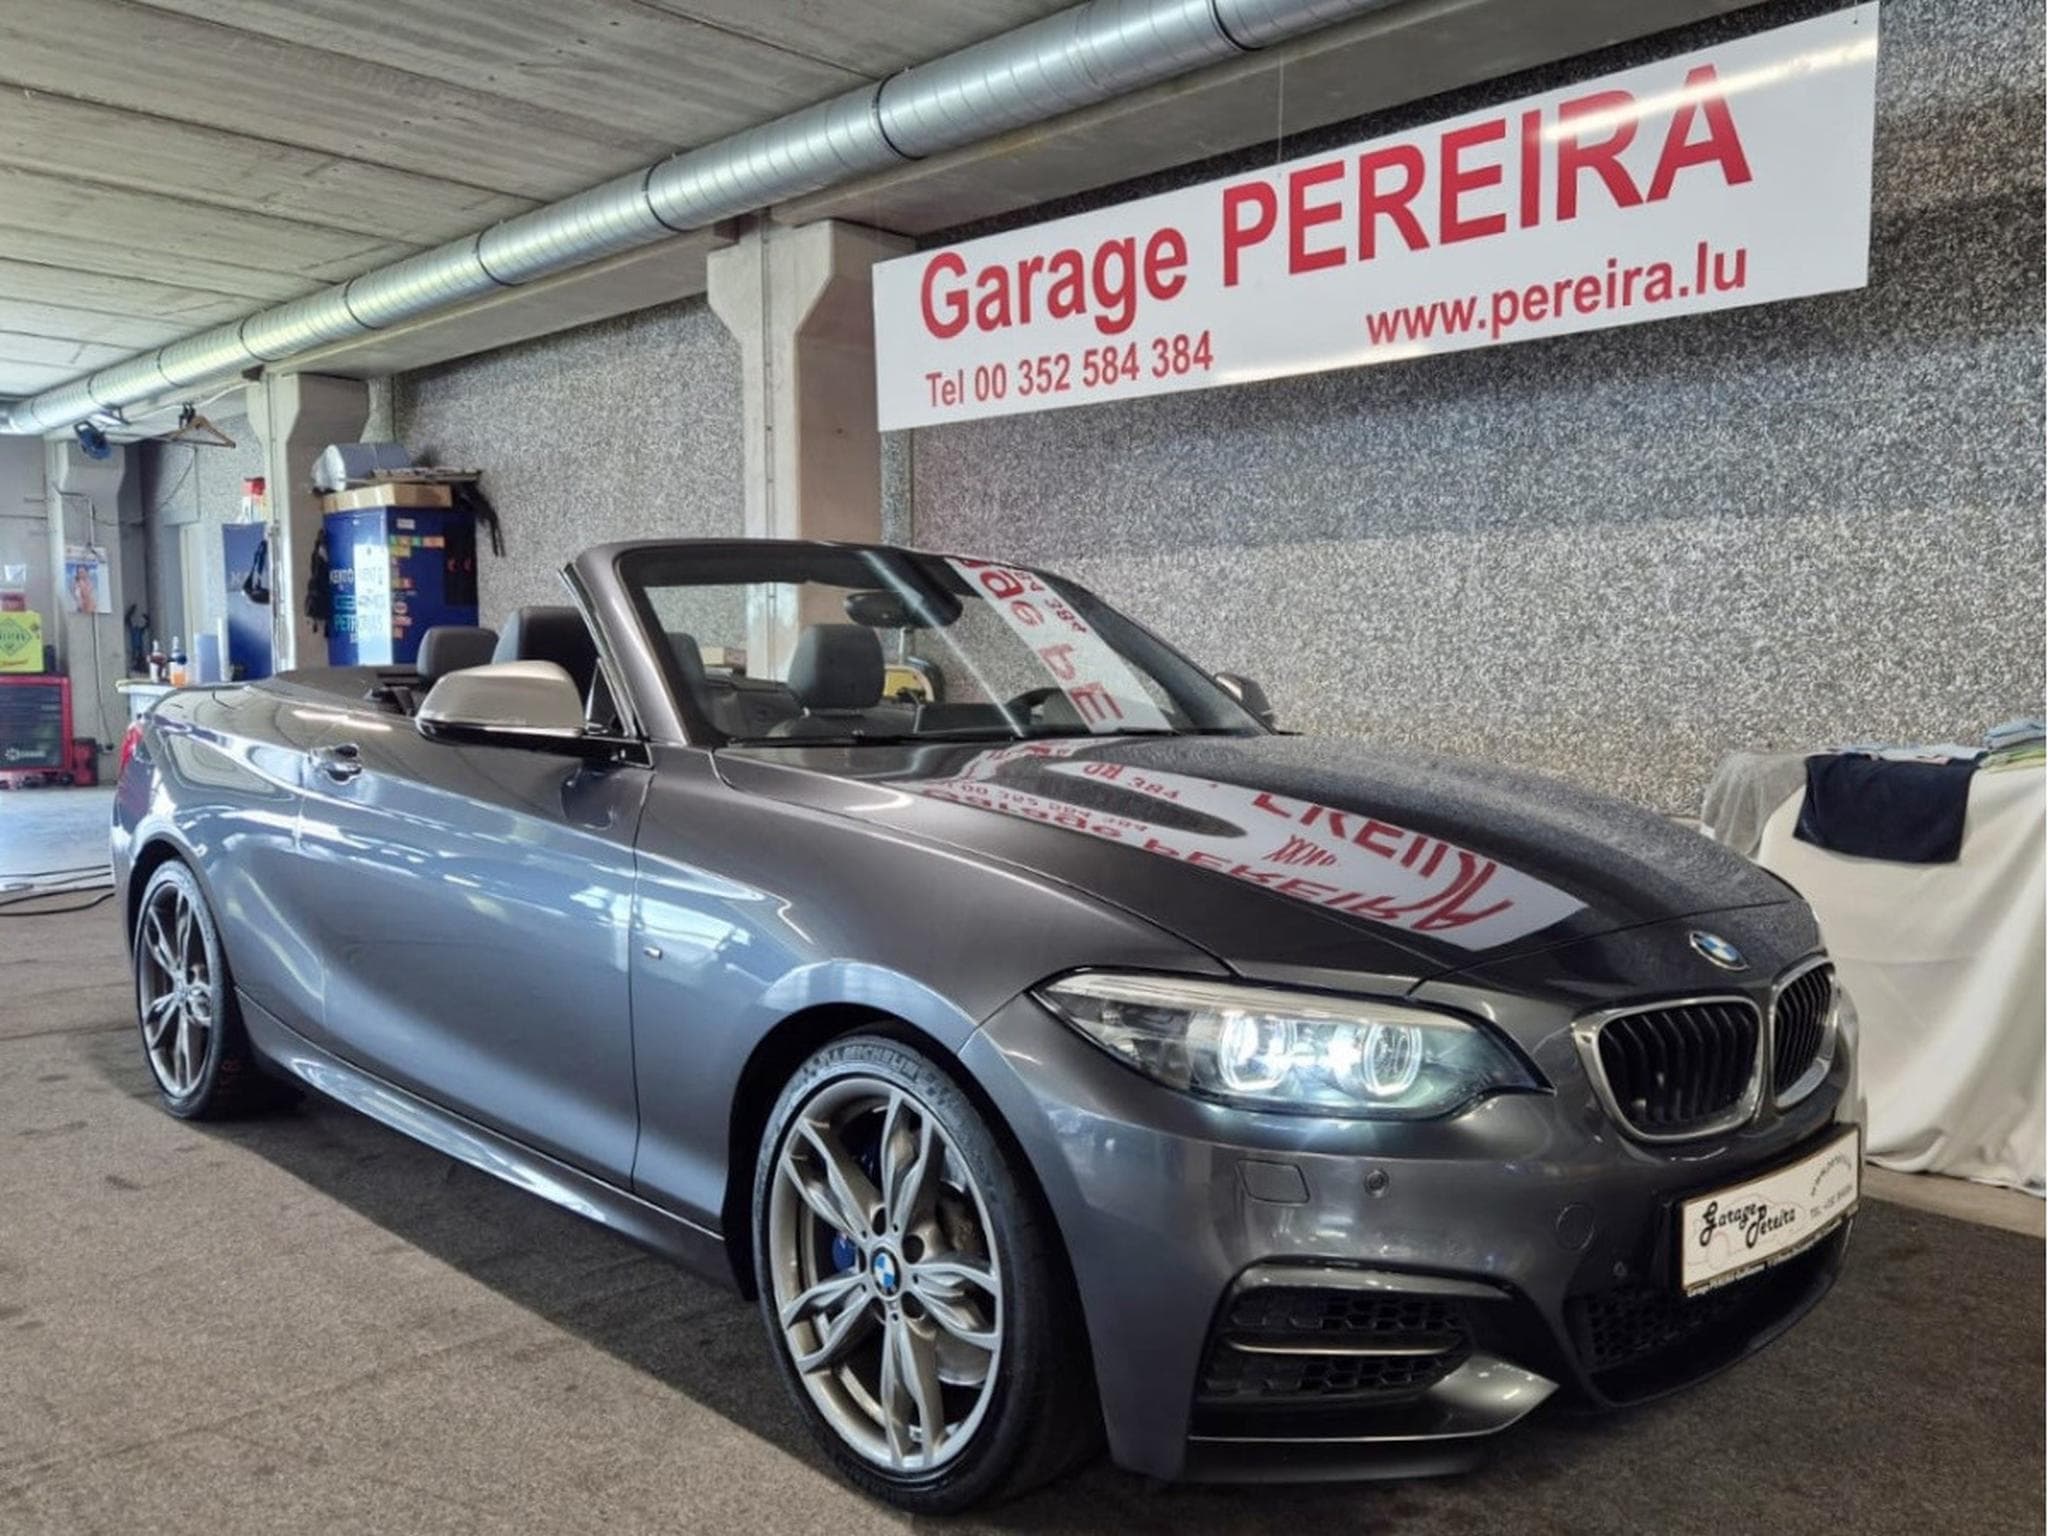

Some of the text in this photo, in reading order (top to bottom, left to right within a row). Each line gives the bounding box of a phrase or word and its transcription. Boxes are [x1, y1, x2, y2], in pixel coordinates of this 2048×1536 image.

[921, 63, 1752, 339] Garage PEREIRA
[1366, 242, 1748, 345] www.pereira.lu
[925, 330, 1214, 407] Tel 00 352 584 384
[1699, 1201, 1757, 1247] Garage
[1745, 1204, 1796, 1249] Pereira
